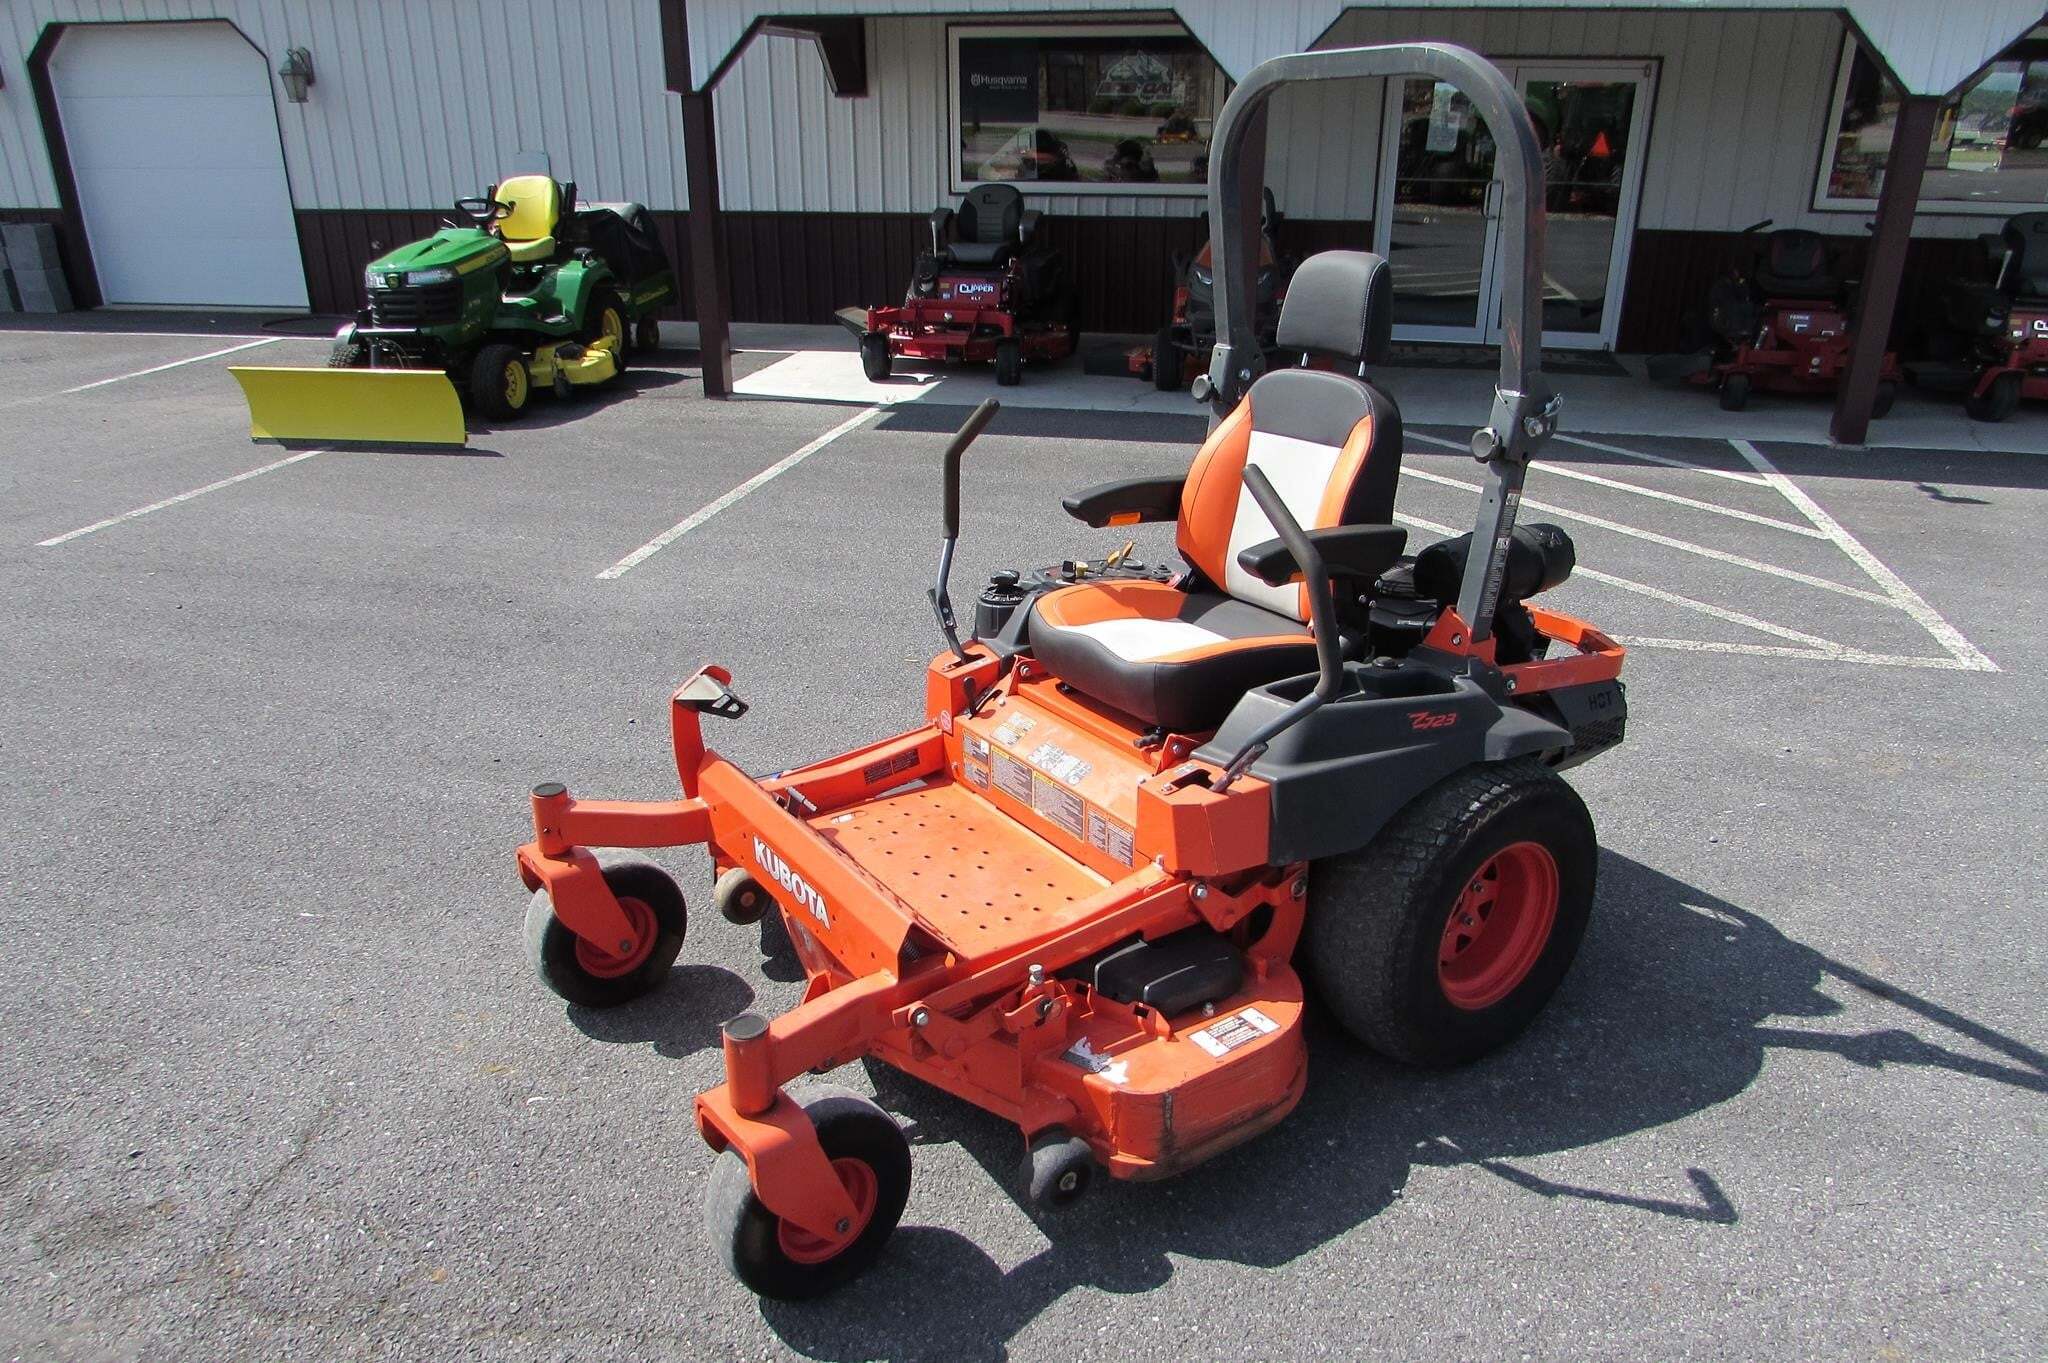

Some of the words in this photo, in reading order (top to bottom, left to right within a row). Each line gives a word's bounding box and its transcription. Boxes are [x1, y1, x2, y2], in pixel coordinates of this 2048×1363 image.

[980, 75, 1027, 86] Husqvarna
[959, 283, 994, 294] CLIPPER
[752, 835, 831, 931] KUBOTA
